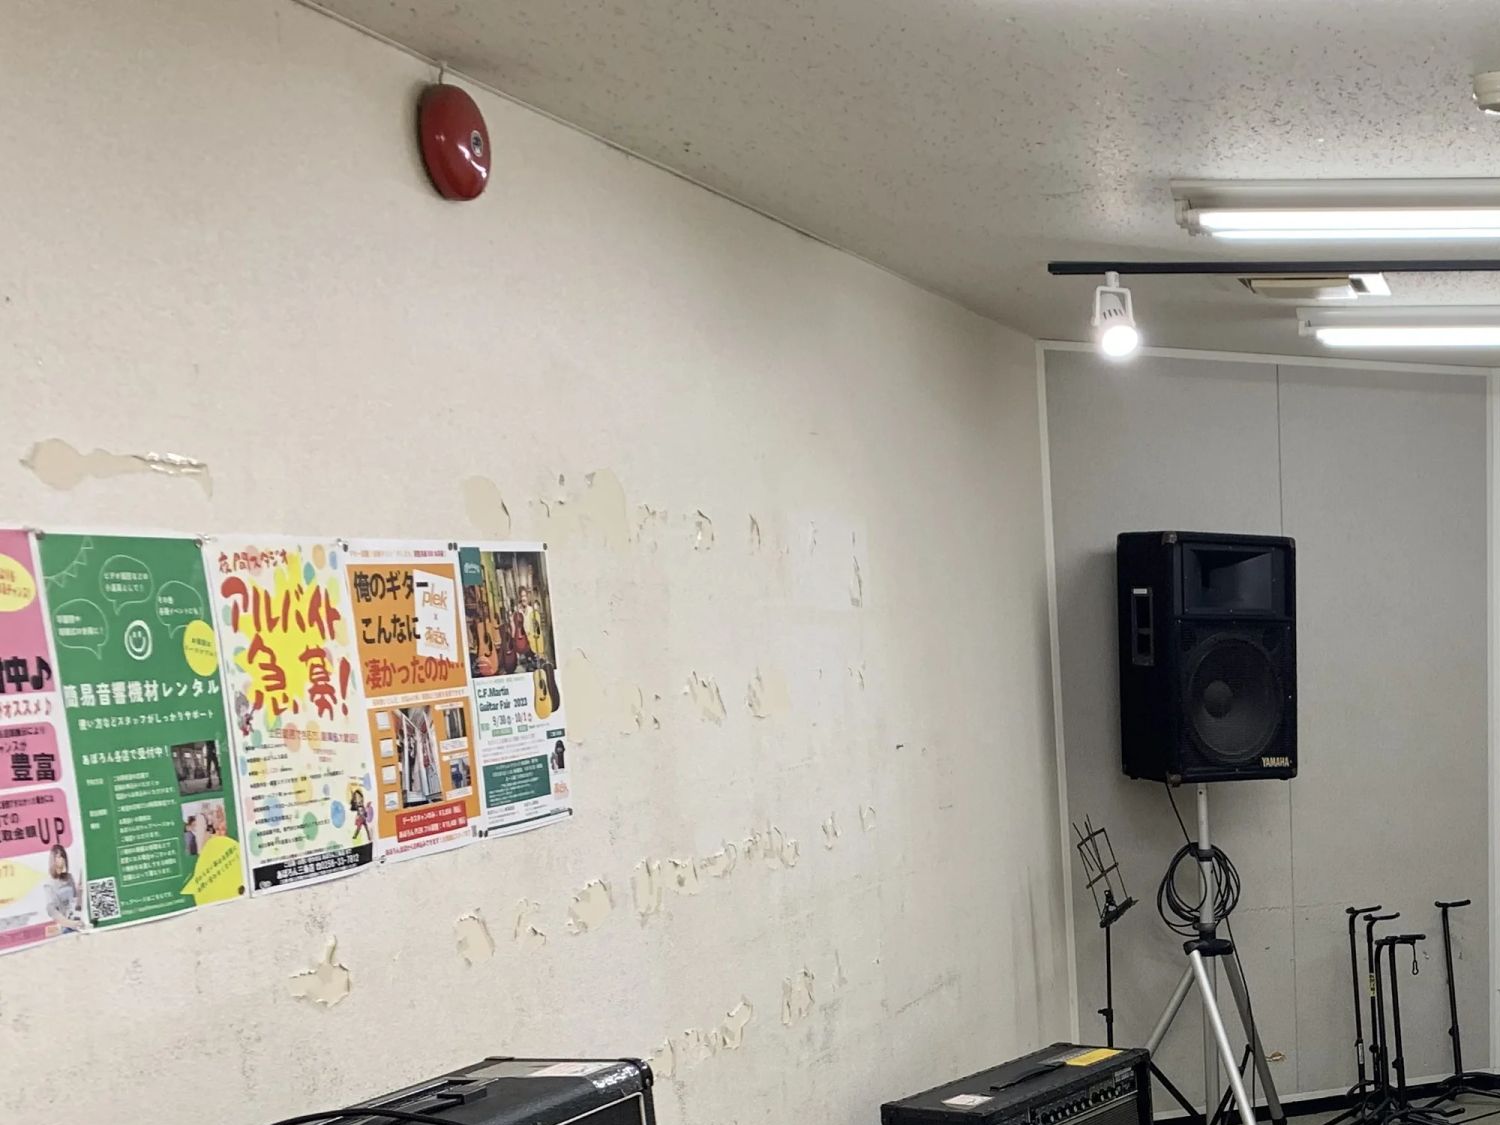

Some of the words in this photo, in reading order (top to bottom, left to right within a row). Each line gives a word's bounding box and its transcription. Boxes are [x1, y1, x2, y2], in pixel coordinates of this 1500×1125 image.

[354, 571, 429, 603] 俺のギター
[221, 576, 341, 641] アルバイト
[361, 614, 421, 644] こんなに
[63, 679, 220, 708] 簡易音響機材レンタル
[11, 752, 56, 782] 豊富
[1262, 757, 1290, 768] YAMAHA
